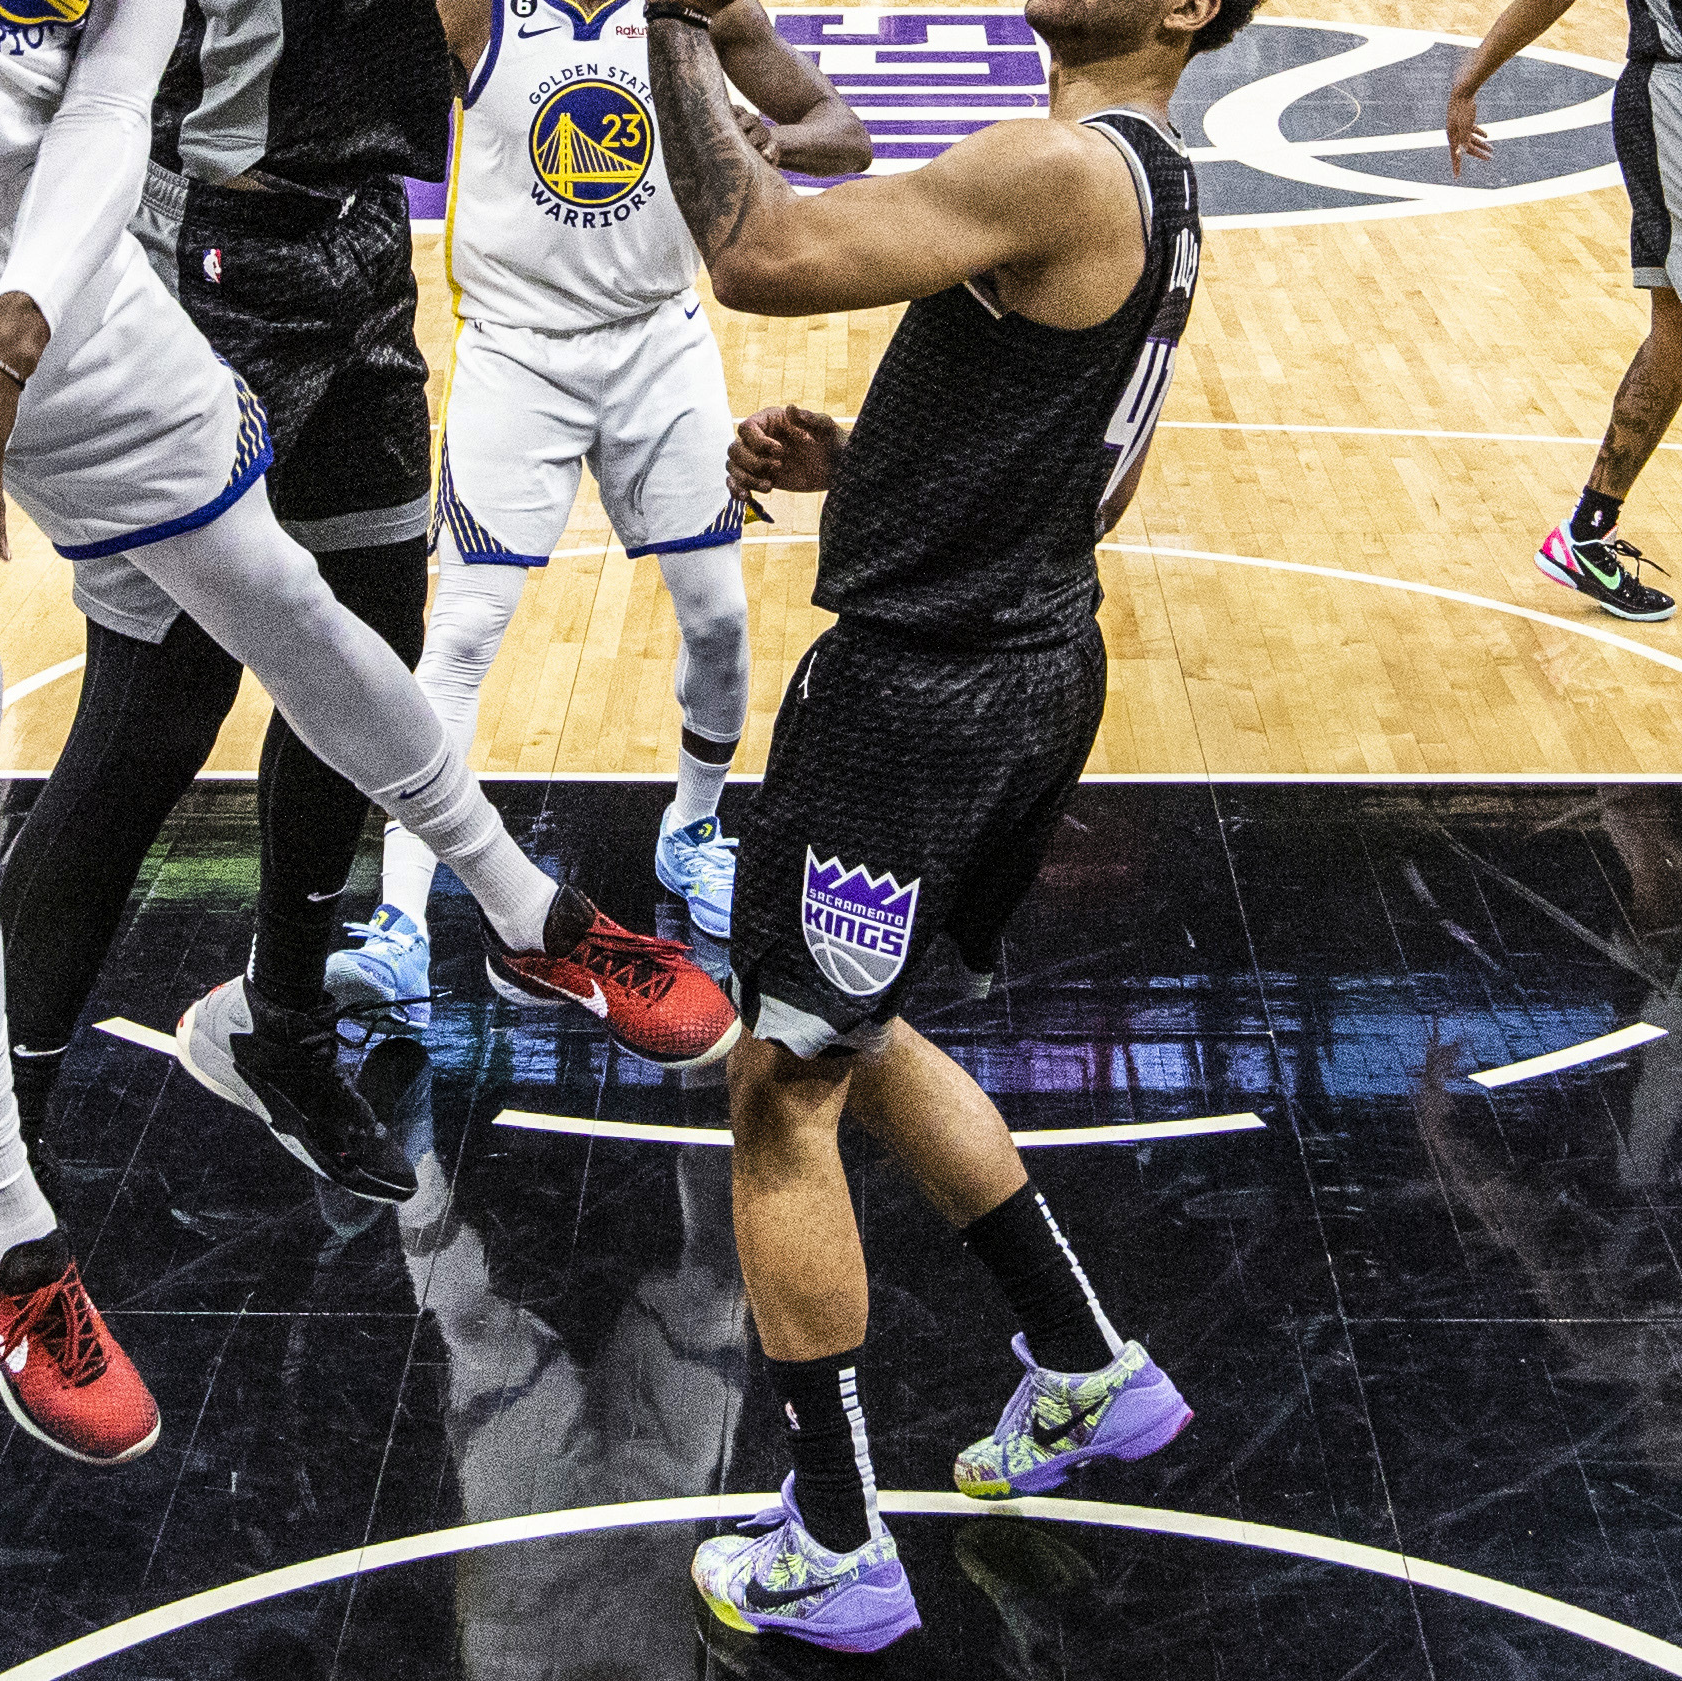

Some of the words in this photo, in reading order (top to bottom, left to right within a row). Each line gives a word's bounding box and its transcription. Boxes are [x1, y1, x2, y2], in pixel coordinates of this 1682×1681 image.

[529, 63, 599, 105] GOLDEN
[601, 113, 641, 150] 23
[530, 178, 657, 229] WARRIORS
[808, 887, 905, 927] SACRAMENTO
[804, 904, 906, 960] KINGS
